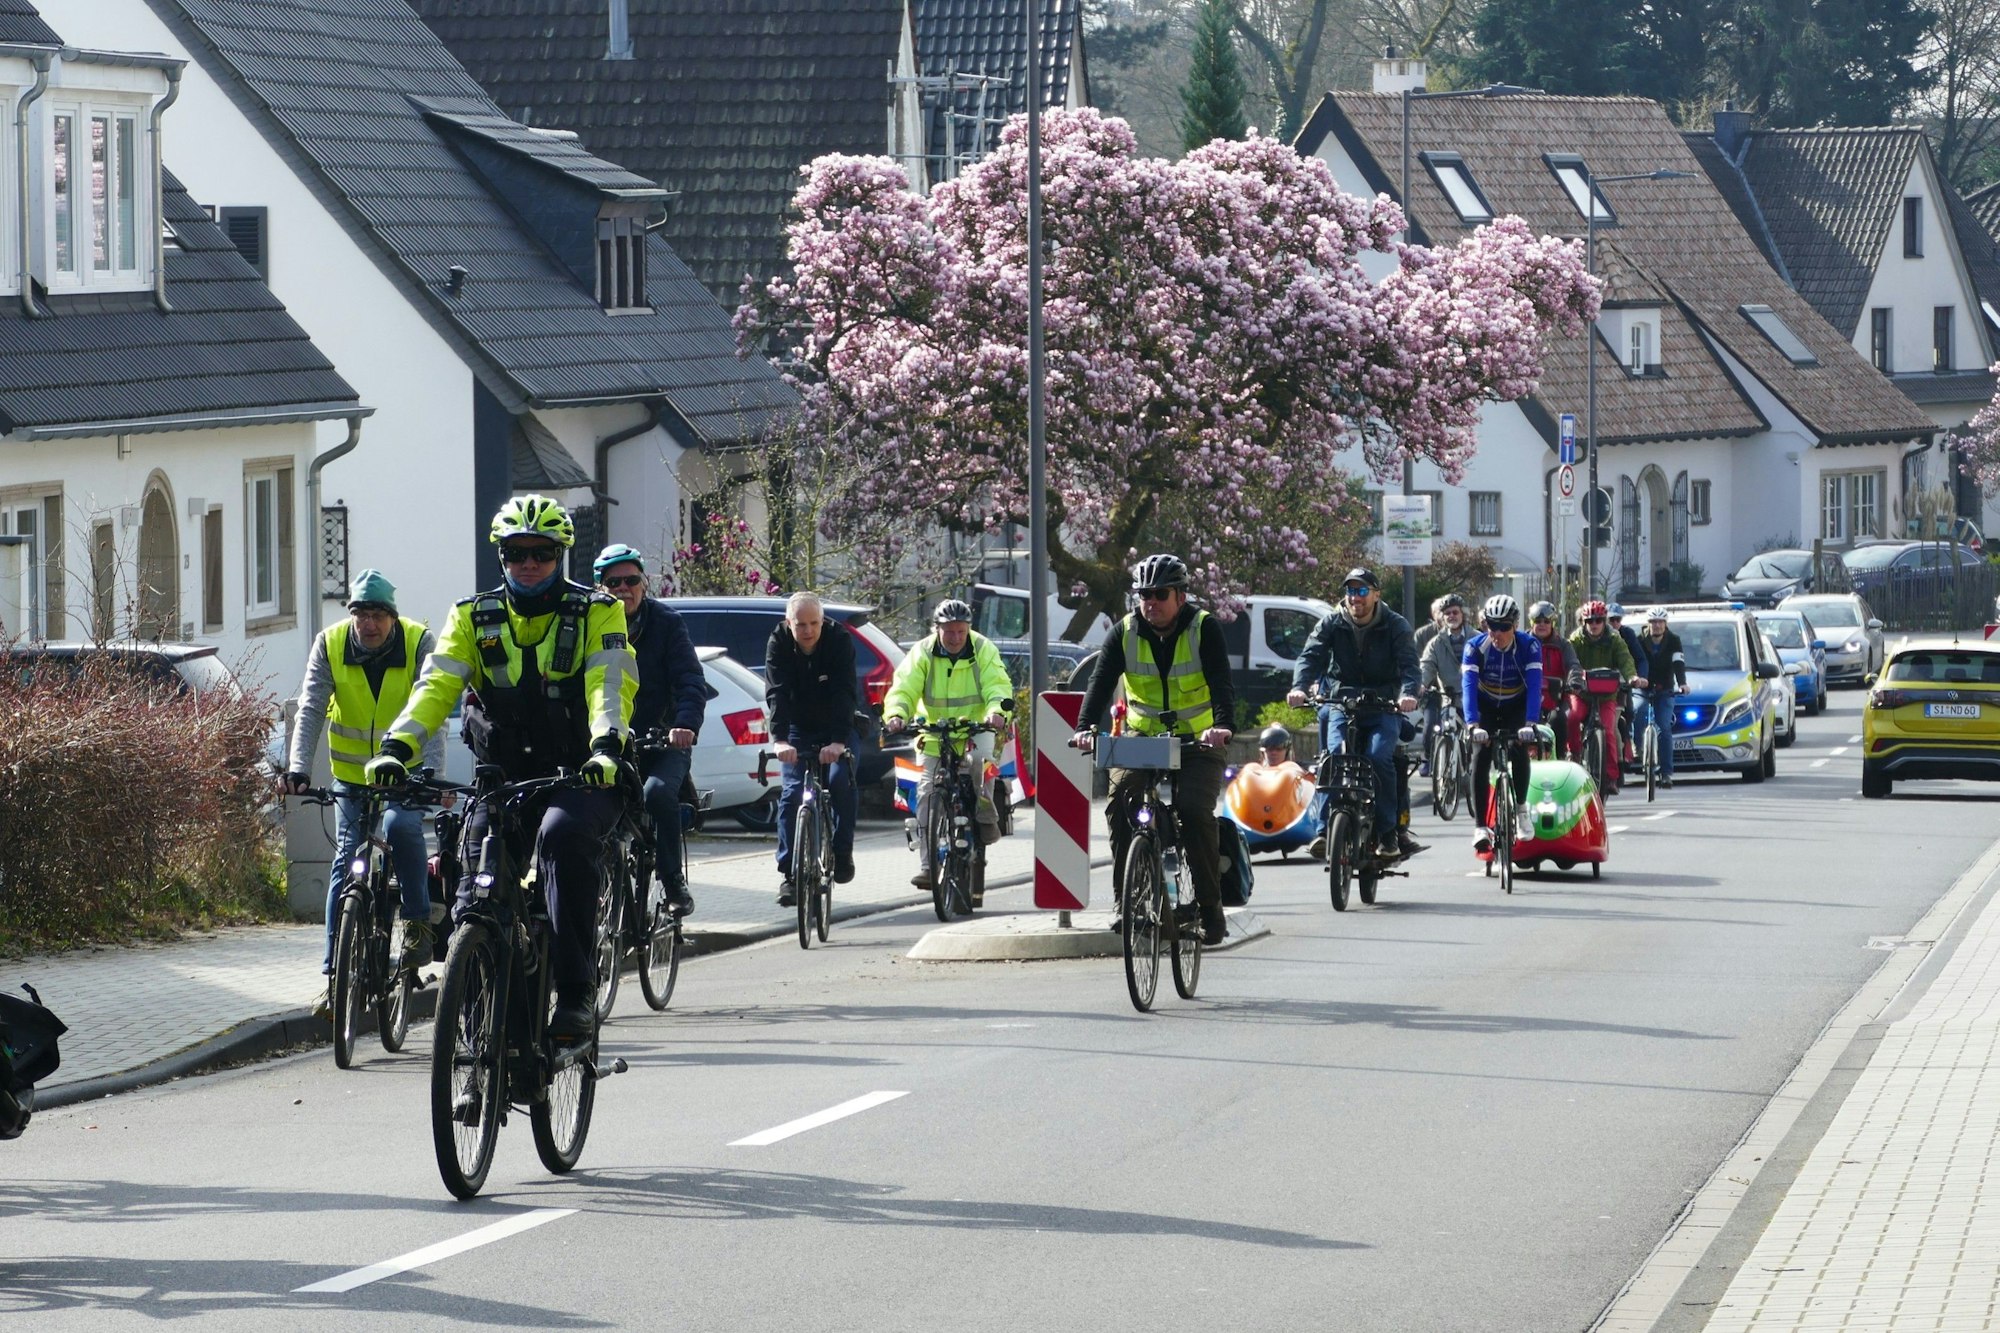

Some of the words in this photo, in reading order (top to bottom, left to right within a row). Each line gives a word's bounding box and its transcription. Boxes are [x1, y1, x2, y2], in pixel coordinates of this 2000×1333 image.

[1934, 705, 1945, 715] SI
[1950, 705, 1963, 716] ND
[1964, 706, 1976, 716] 60
